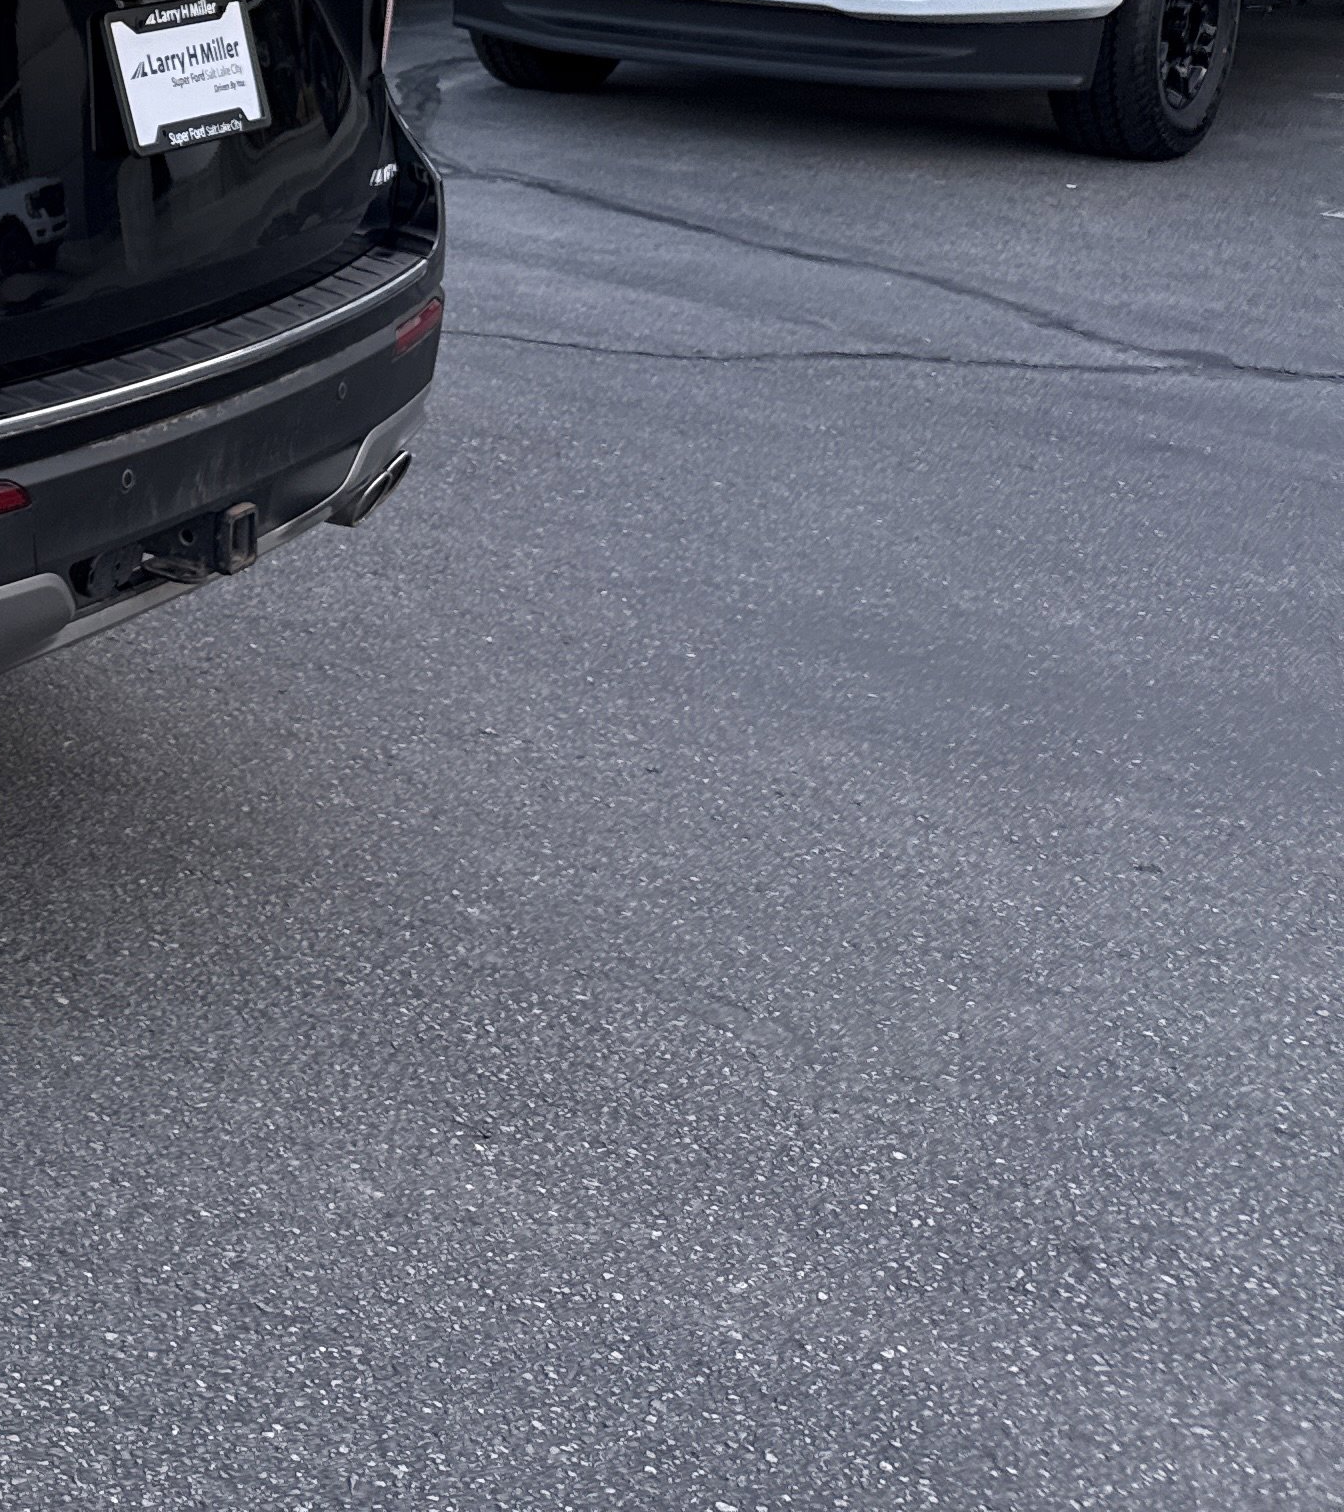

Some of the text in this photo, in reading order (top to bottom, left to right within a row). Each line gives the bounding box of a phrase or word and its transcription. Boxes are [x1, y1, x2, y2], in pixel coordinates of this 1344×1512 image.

[155, 0, 216, 23] Larry H Miller
[146, 36, 239, 75] Larry H Miller
[168, 131, 190, 146] Super
[188, 124, 206, 140] Ford
